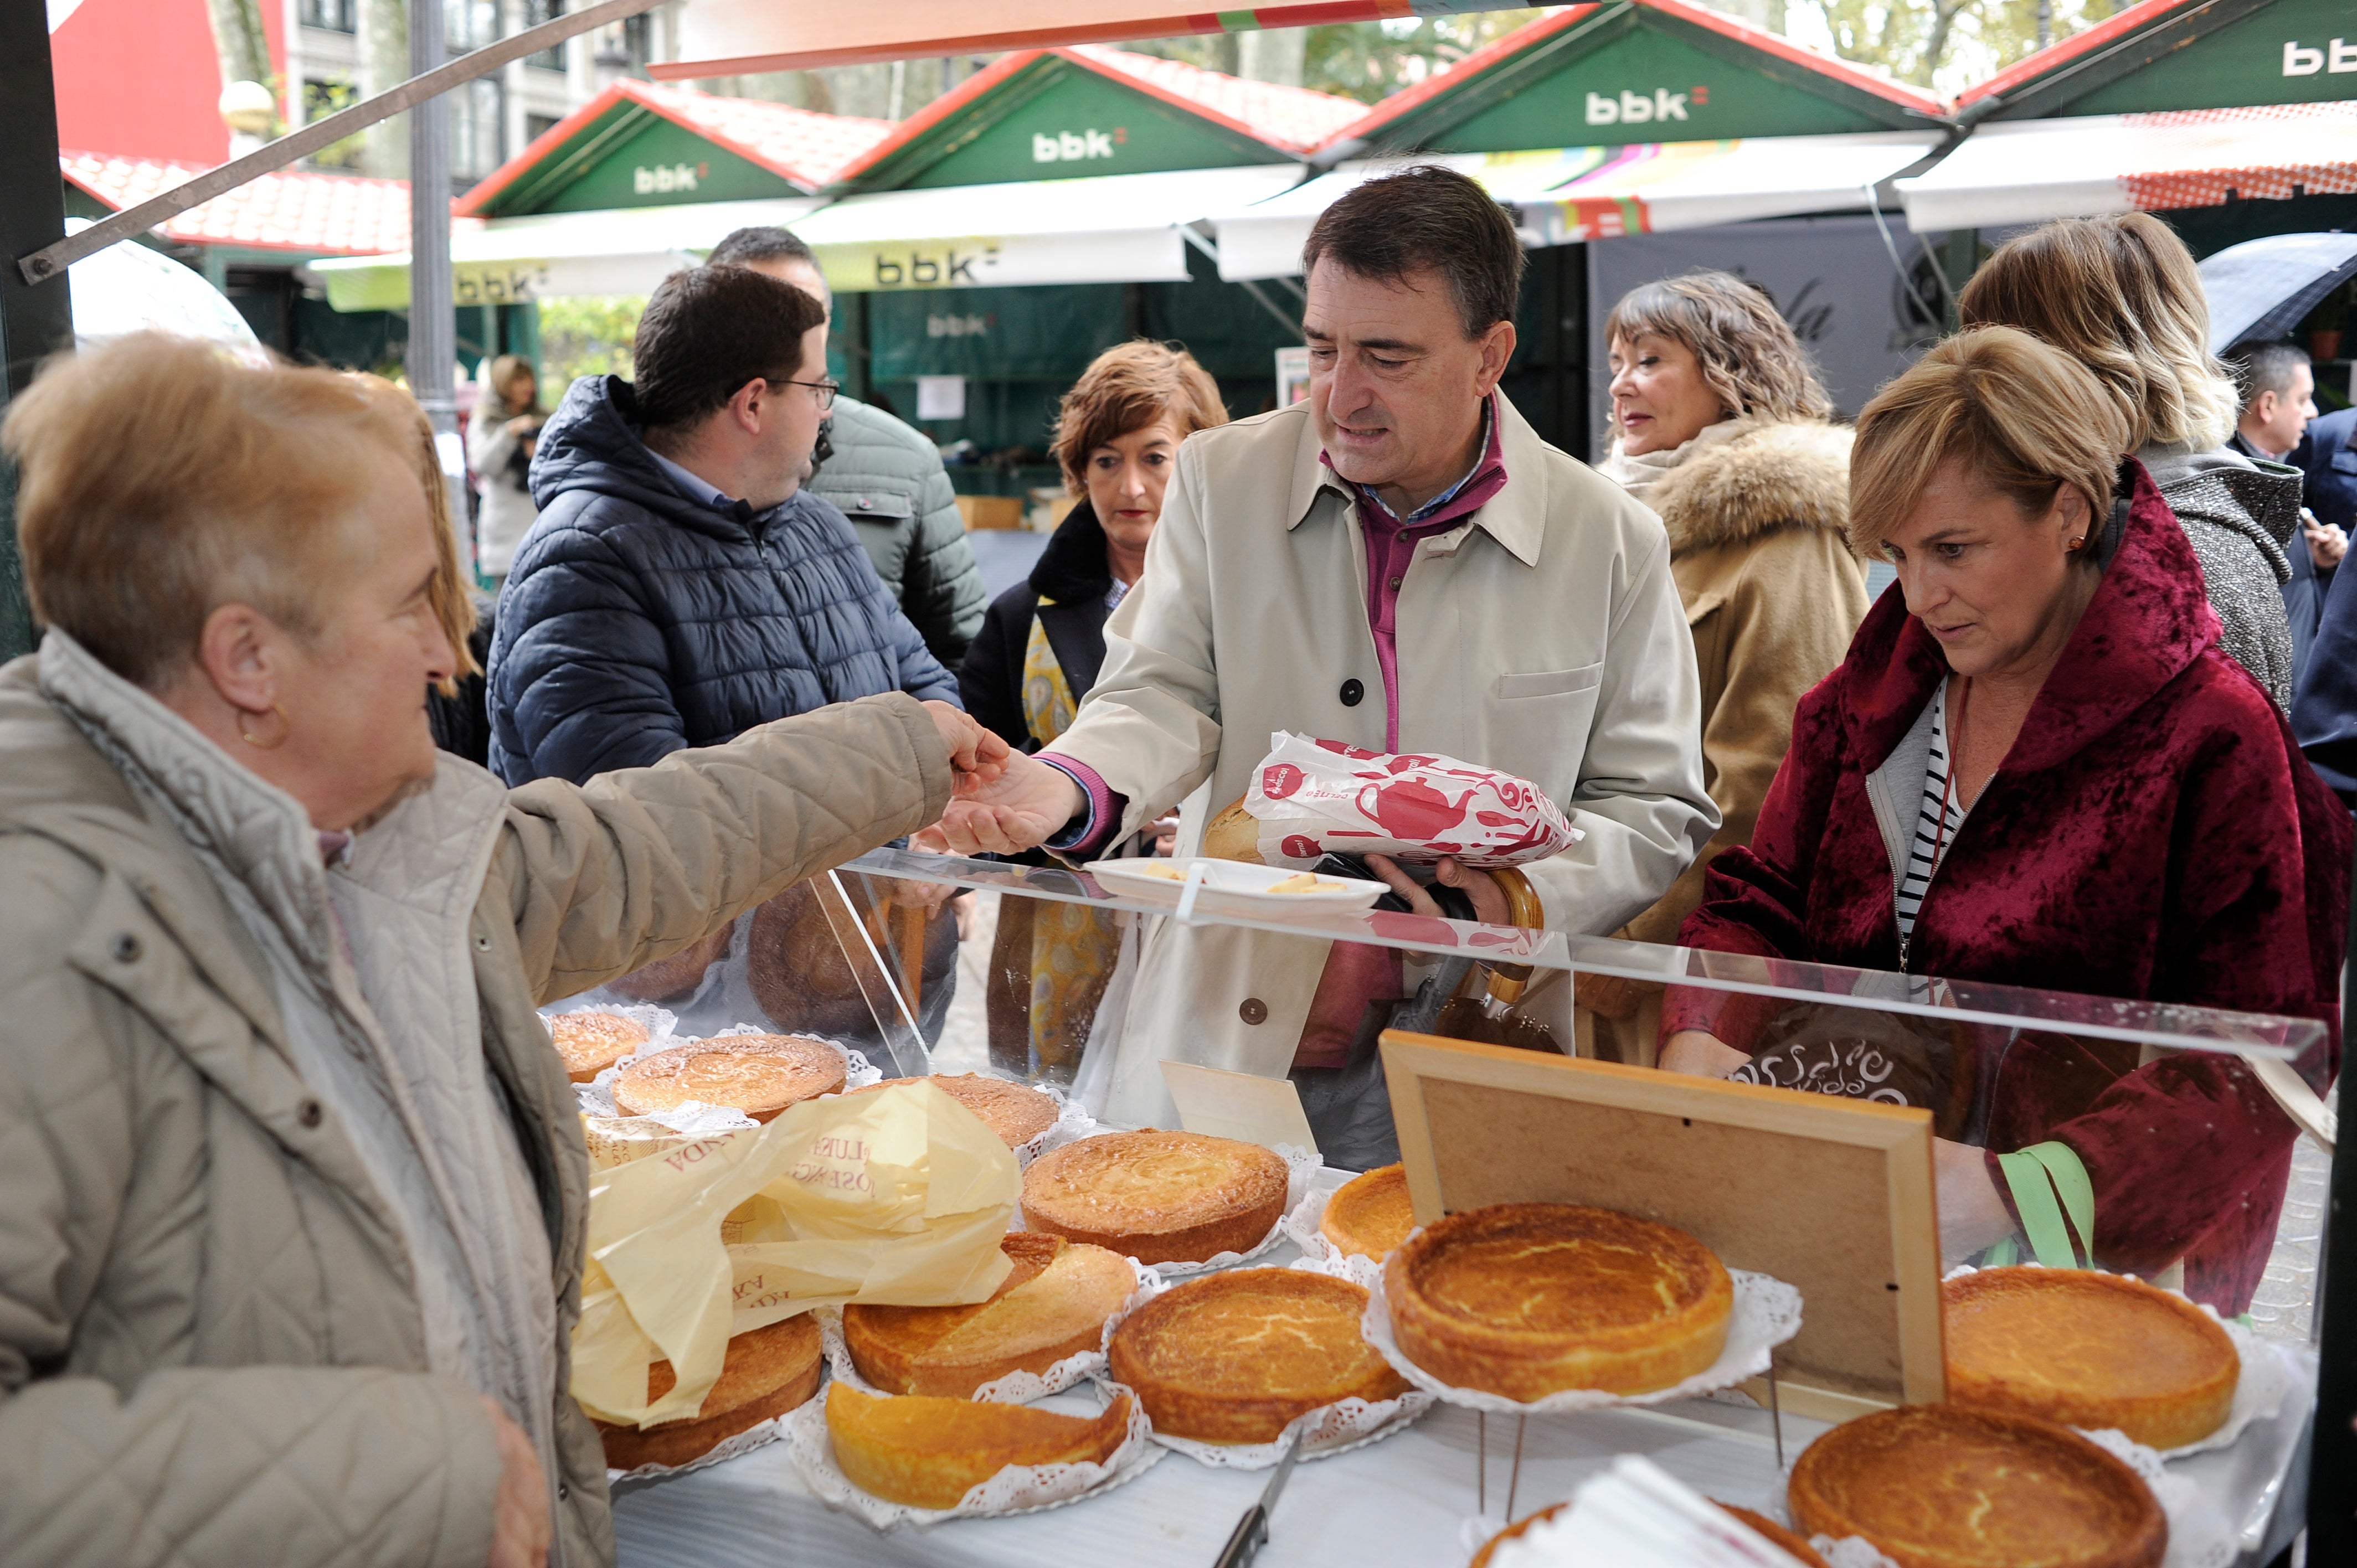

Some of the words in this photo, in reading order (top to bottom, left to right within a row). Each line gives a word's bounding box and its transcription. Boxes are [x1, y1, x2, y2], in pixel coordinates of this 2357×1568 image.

[2282, 37, 2357, 76] bb
[1585, 88, 1688, 126] bbk
[1032, 128, 1114, 163] bbk
[634, 163, 698, 195] bbk
[876, 248, 977, 285] bbk
[456, 267, 535, 302] bbk
[927, 313, 987, 338] bbk
